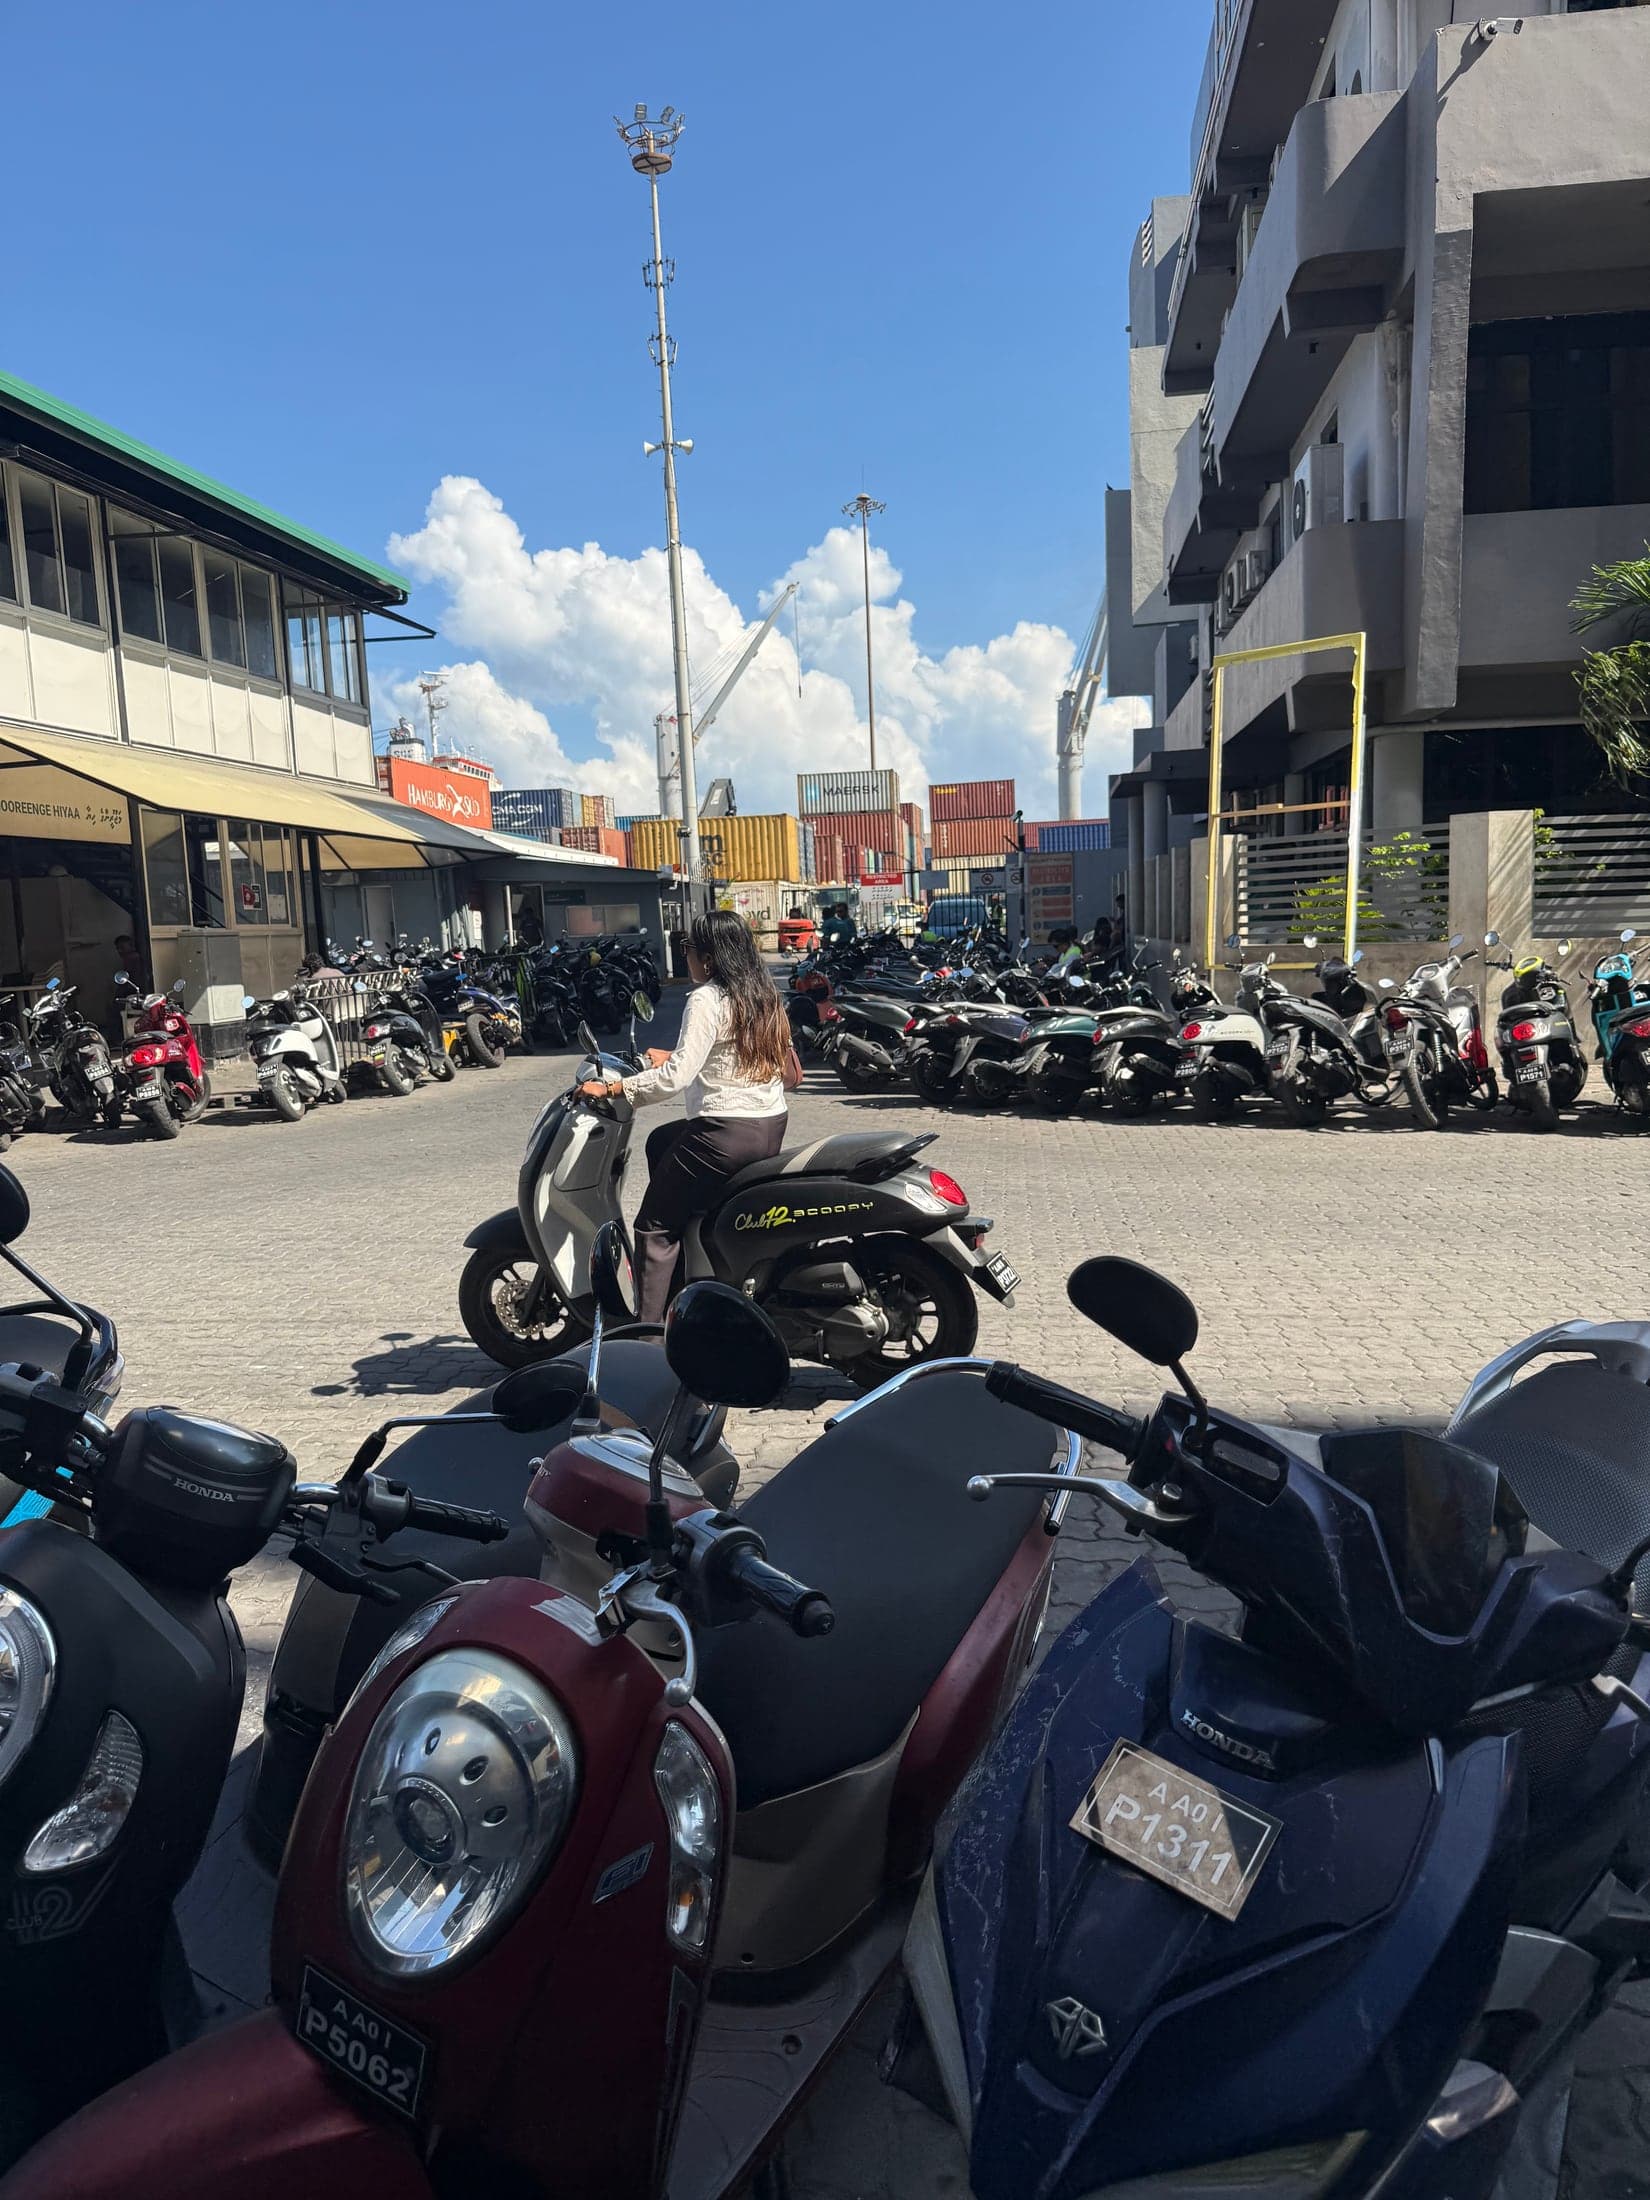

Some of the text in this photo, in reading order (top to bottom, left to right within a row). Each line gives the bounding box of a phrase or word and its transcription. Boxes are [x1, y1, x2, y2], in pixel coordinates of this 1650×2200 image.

[407, 783, 453, 813] HAMBURG
[824, 784, 881, 797] MAERSK
[53, 805, 81, 819] HIYAA
[518, 803, 543, 815] CGM
[1520, 1071, 1544, 1081] P1571
[173, 1477, 236, 1503] HONDA
[1180, 1708, 1276, 1771] HONDA
[1148, 1781, 1169, 1805] A
[1104, 1792, 1233, 1887] P1311
[332, 1999, 349, 2021] A
[305, 2005, 411, 2104] P5062
